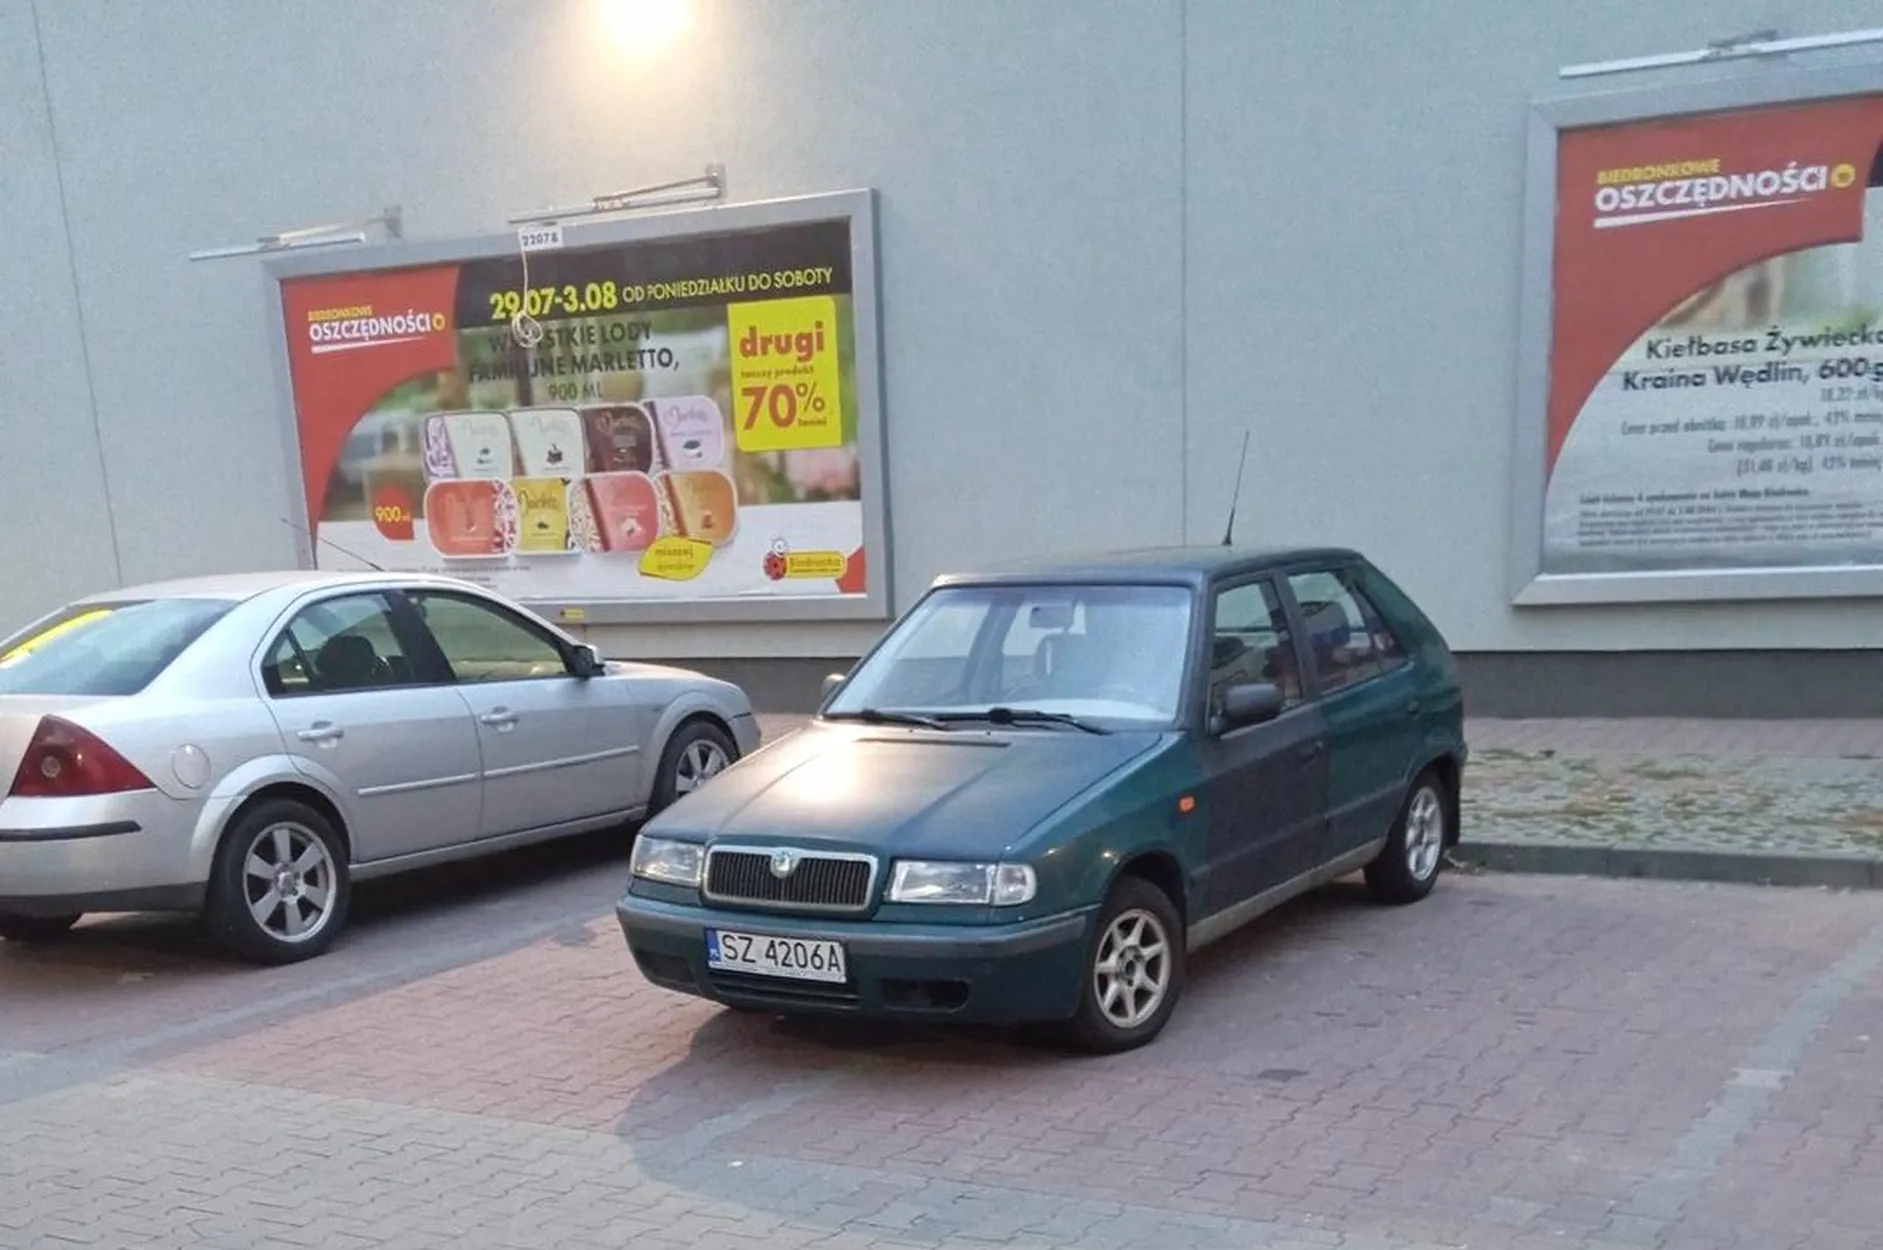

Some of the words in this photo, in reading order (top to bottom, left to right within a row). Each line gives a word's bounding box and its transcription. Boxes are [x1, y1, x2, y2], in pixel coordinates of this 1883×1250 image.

[1594, 161, 1829, 212] OSZCZĘDNOŚCI
[489, 280, 618, 320] 2907-3.08
[622, 285, 645, 303] OD
[647, 274, 746, 301] PONIEDZIAŁKU
[748, 274, 772, 290] DO
[773, 266, 833, 289] SOBOTY
[308, 309, 431, 342] OSZCZĘDNOŚCI
[601, 319, 652, 345] LODY
[739, 320, 824, 362] drugi
[570, 346, 680, 378] MARLETTO,
[1646, 335, 1758, 359] Kiełbasa
[1622, 368, 1706, 391] Kraina
[1713, 358, 1810, 388] Wędlin,
[548, 382, 578, 401] 900
[741, 382, 826, 430] 70%
[375, 506, 400, 522] 900
[721, 933, 756, 963] SZ
[765, 939, 842, 973] 4206A
